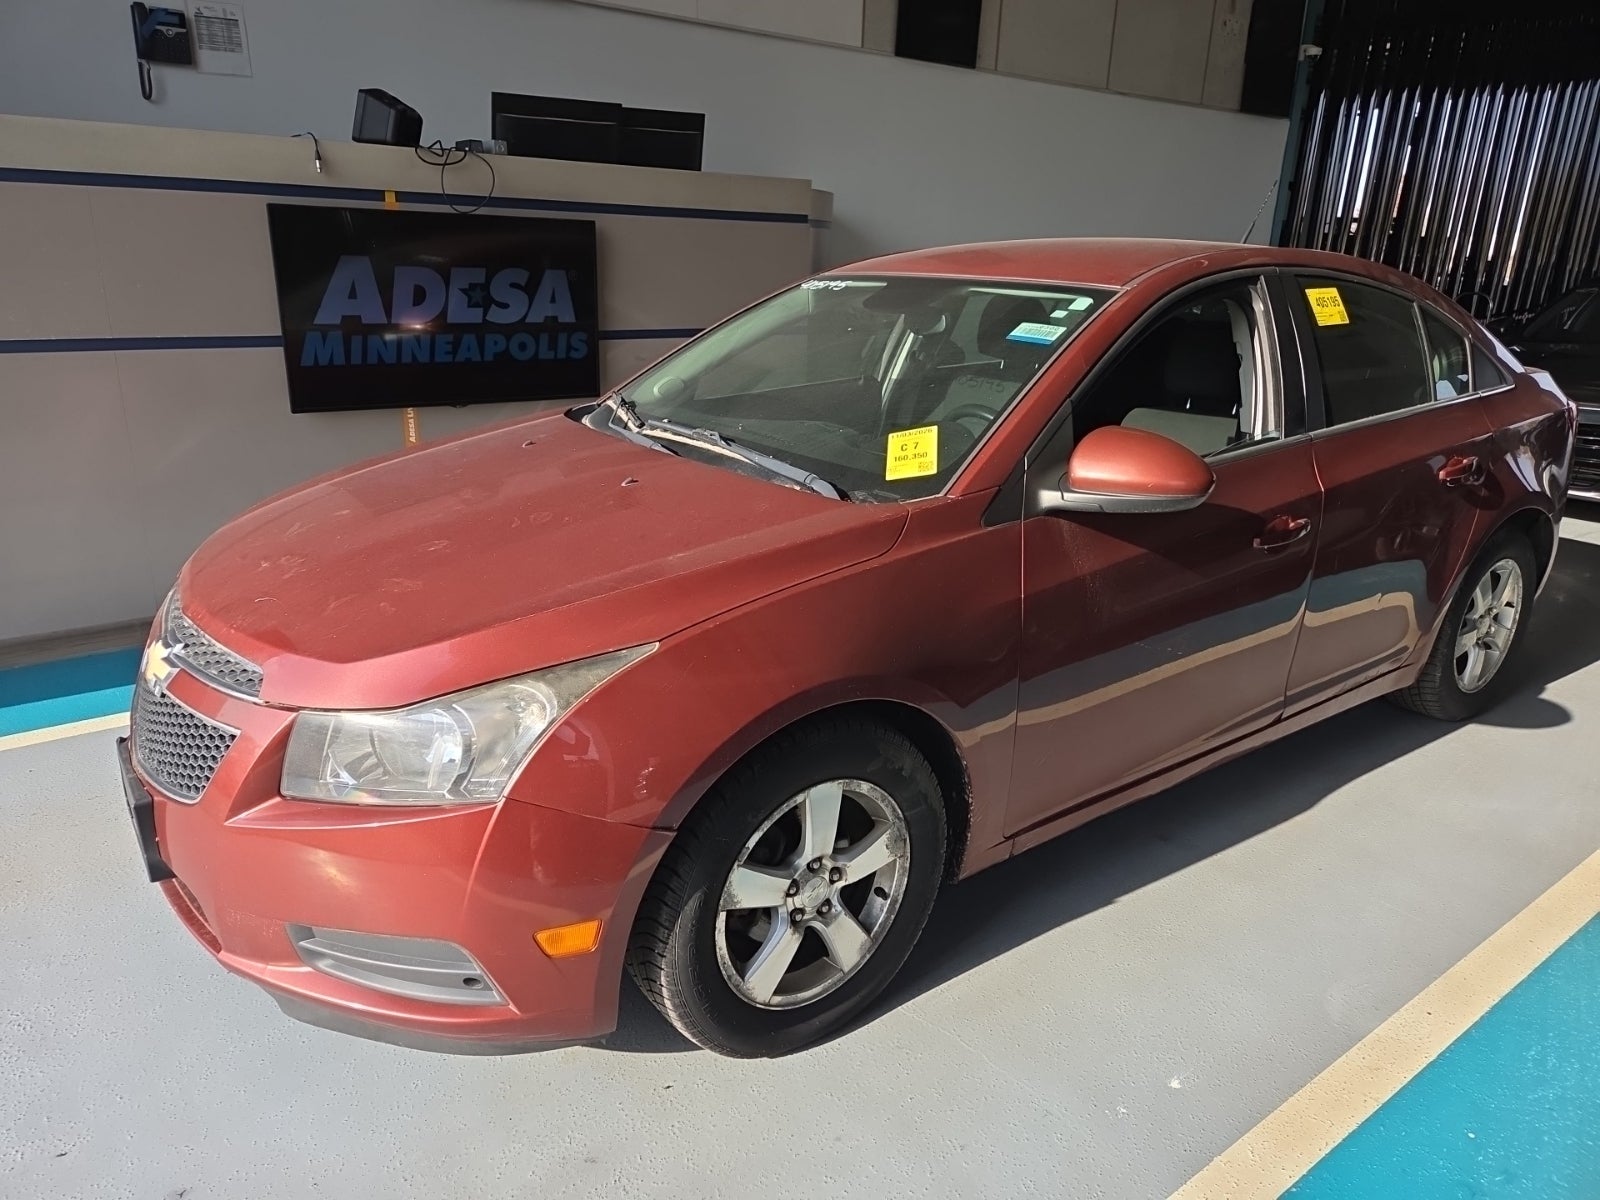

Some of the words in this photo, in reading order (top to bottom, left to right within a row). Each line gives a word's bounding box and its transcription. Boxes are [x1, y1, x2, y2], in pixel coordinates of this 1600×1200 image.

[313, 255, 577, 324] ADESA
[1315, 296, 1340, 308] 405195
[300, 330, 588, 367] MINNEAPOLIS
[408, 418, 416, 443] ADESA
[900, 443, 908, 452] C
[912, 441, 919, 450] 7
